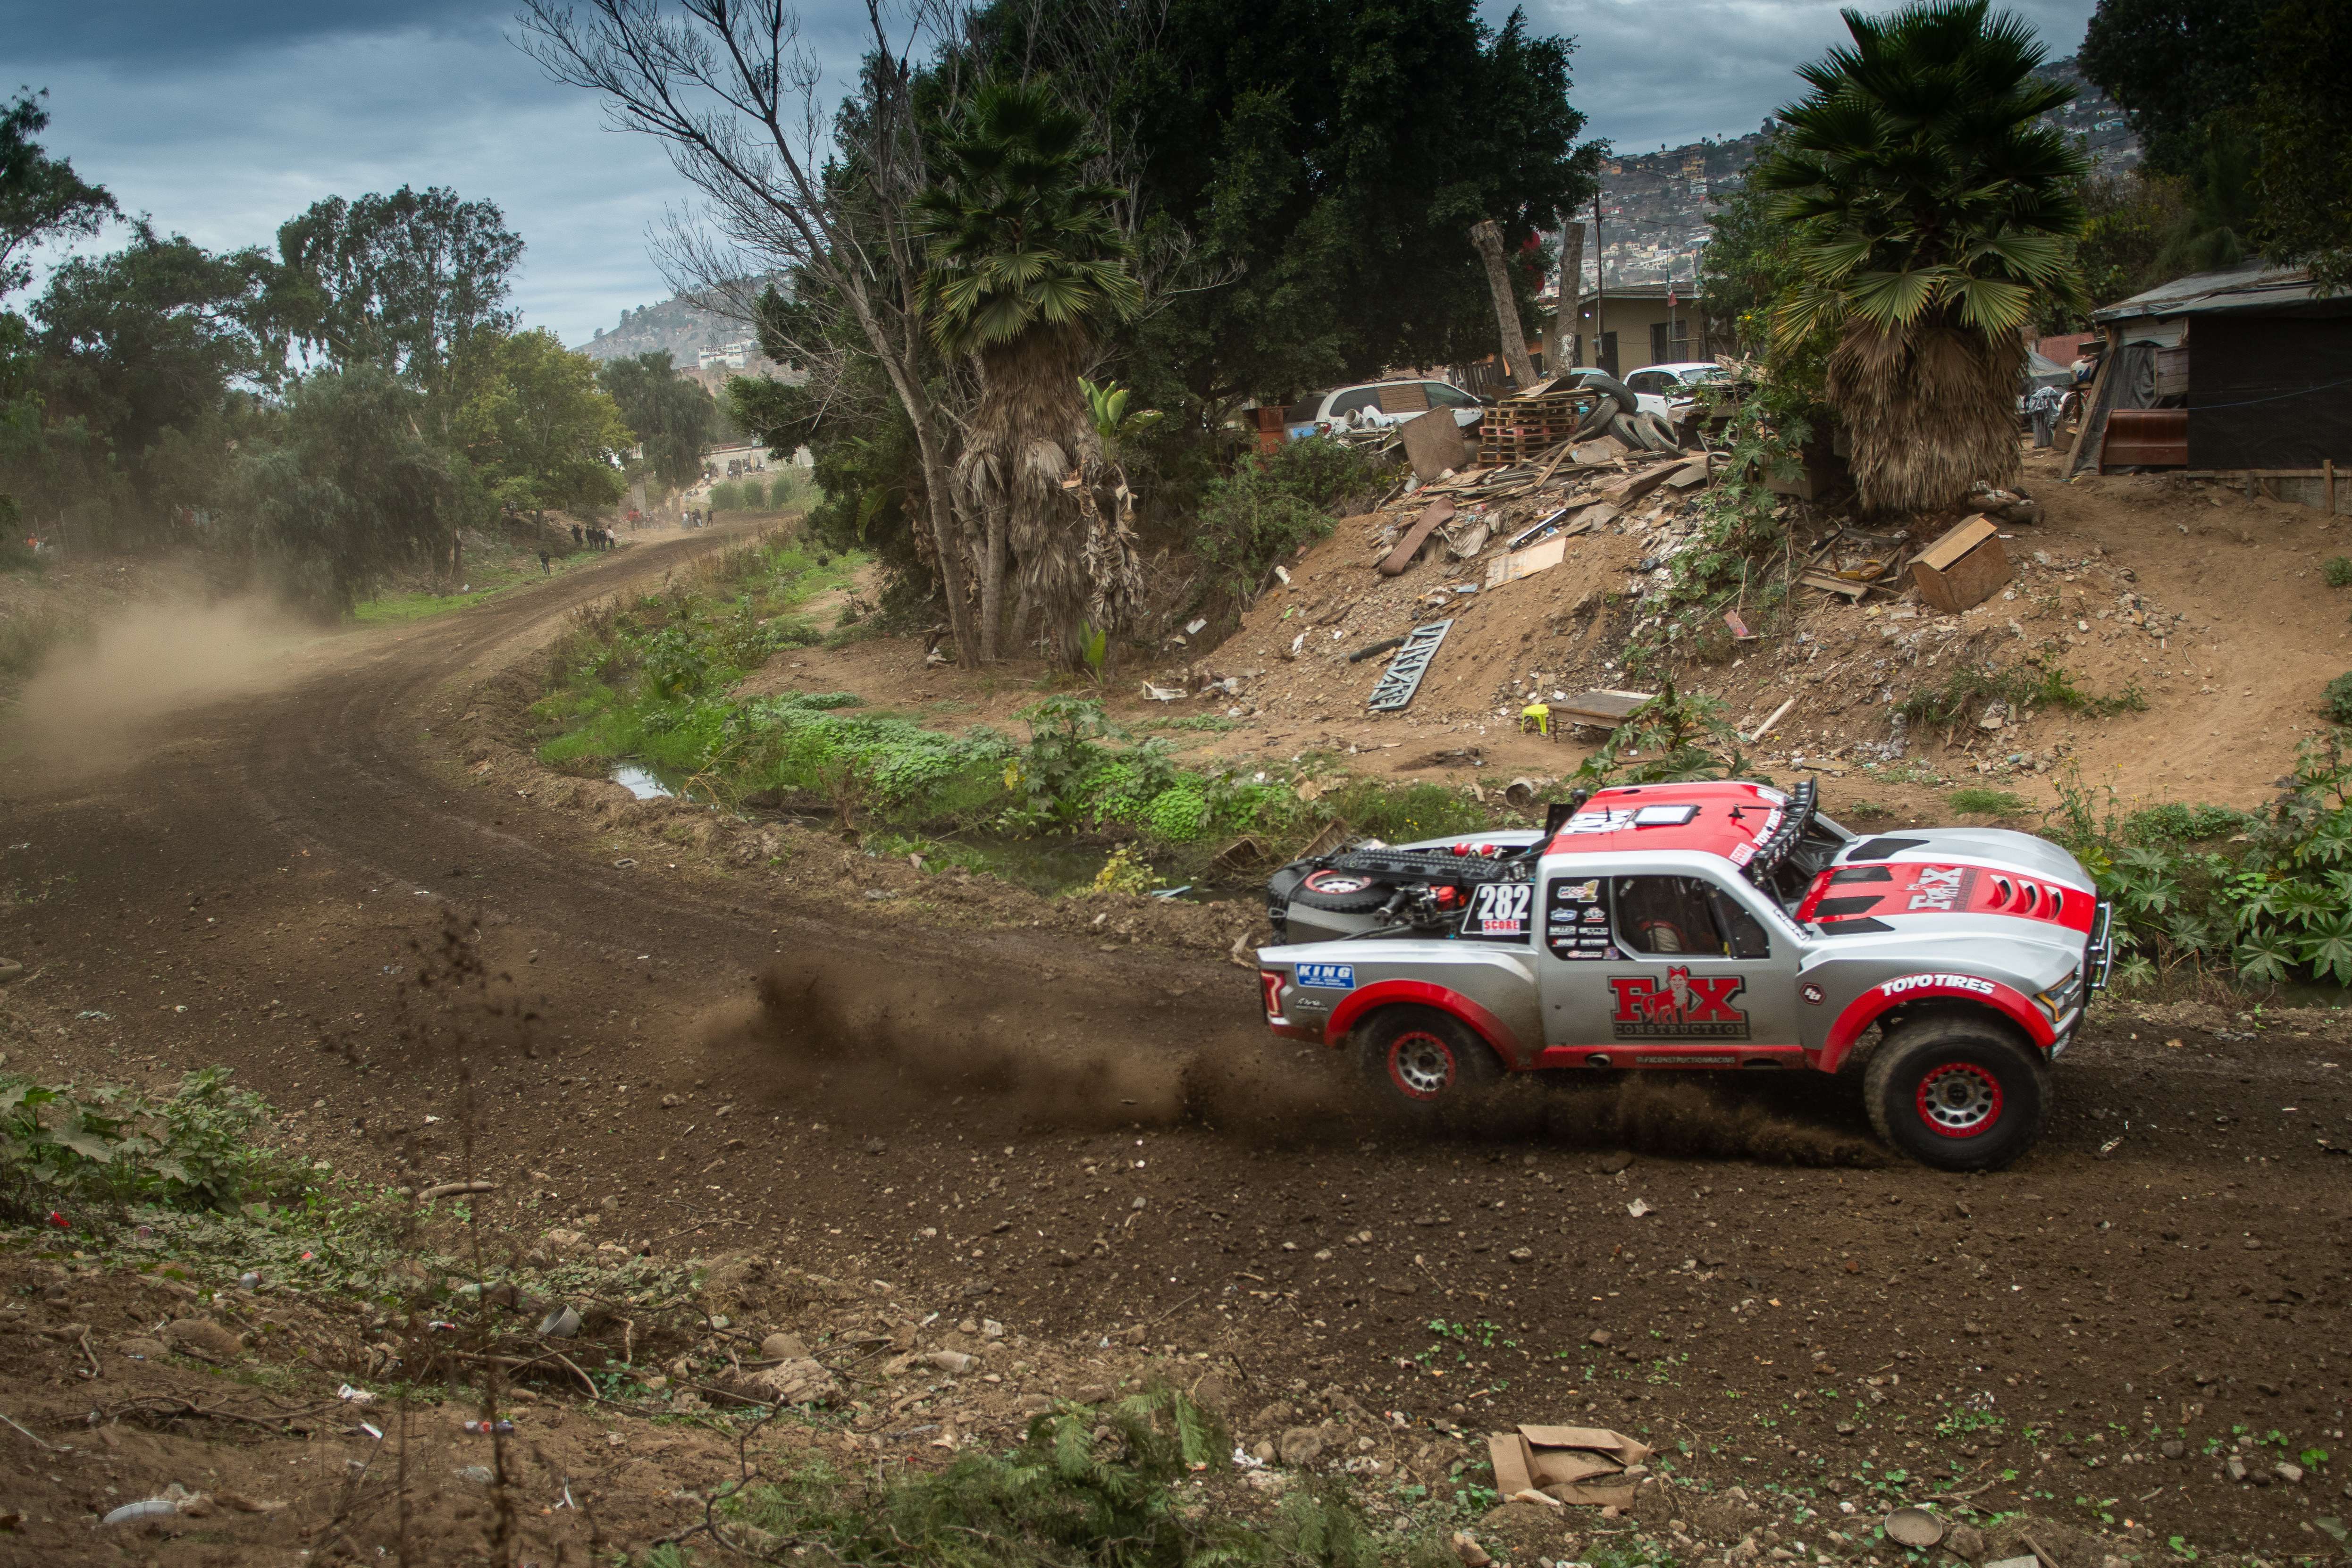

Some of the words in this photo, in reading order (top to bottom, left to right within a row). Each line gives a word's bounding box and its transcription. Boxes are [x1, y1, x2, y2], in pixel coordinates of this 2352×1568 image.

[1732, 844, 1750, 862] SCORE
[1478, 885, 1530, 920] 282
[1484, 920, 1519, 930] SCORE
[1774, 910, 1807, 940] 282
[1299, 965, 1351, 978] KING
[1881, 974, 1934, 997] TOYO
[1934, 974, 1996, 995] TIRES
[1613, 1024, 1746, 1034] CONSTRUCTION
